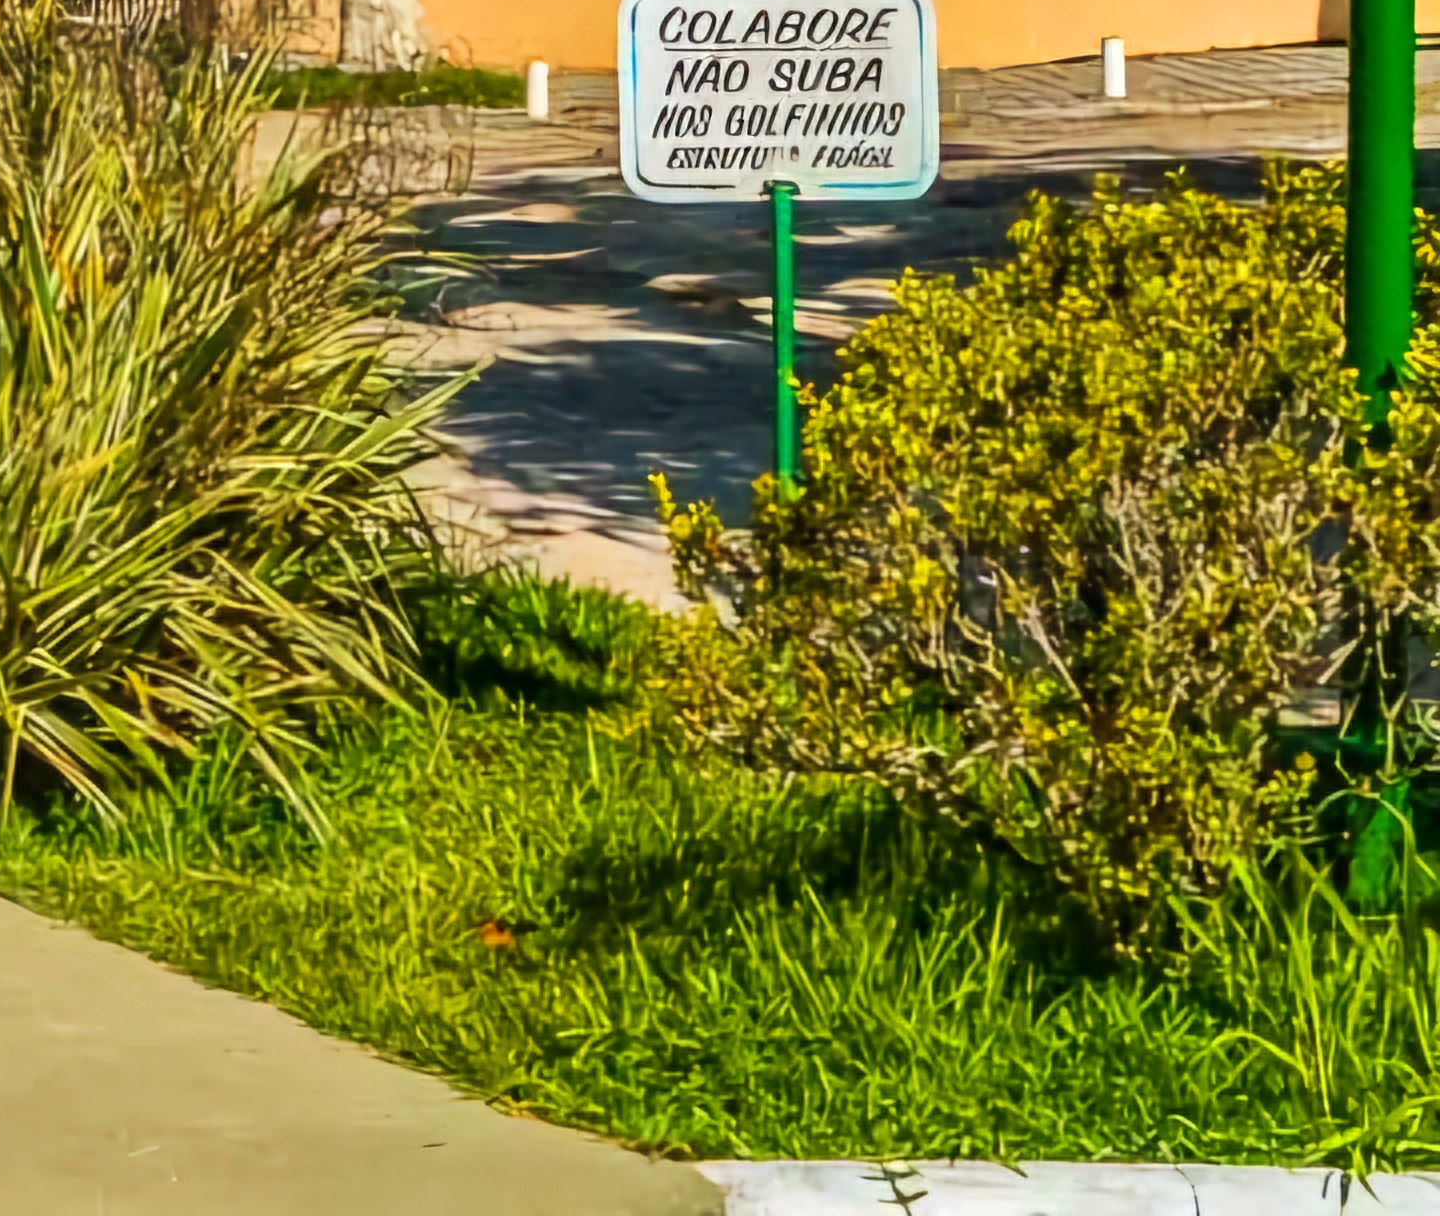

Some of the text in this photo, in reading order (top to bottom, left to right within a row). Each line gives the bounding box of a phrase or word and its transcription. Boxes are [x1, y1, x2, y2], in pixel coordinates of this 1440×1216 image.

[658, 5, 898, 45] COLABORE
[767, 57, 883, 93] SUBA
[652, 102, 906, 139] NOS GOLFINHOS
